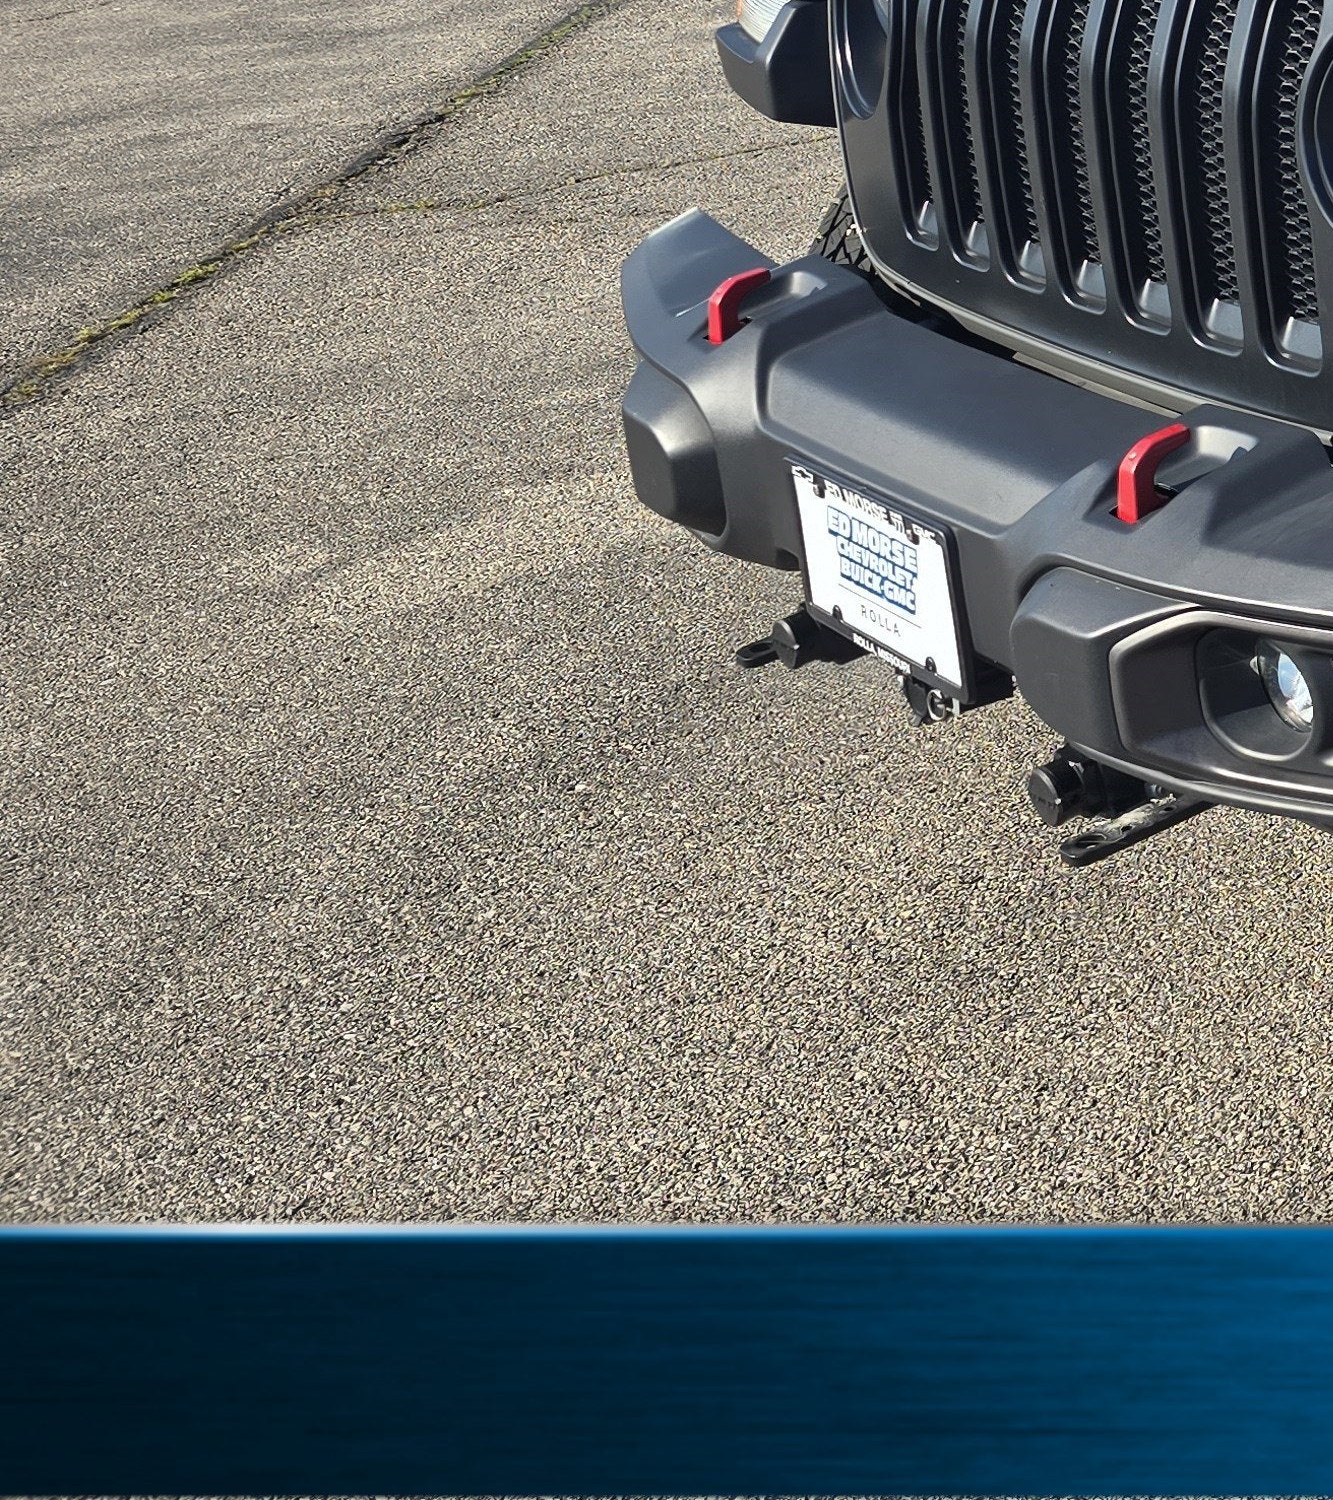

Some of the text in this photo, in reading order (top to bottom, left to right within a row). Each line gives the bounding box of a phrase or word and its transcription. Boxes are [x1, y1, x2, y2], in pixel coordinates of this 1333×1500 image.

[827, 505, 918, 577] ED MORSE
[861, 604, 901, 638] ROLLA
